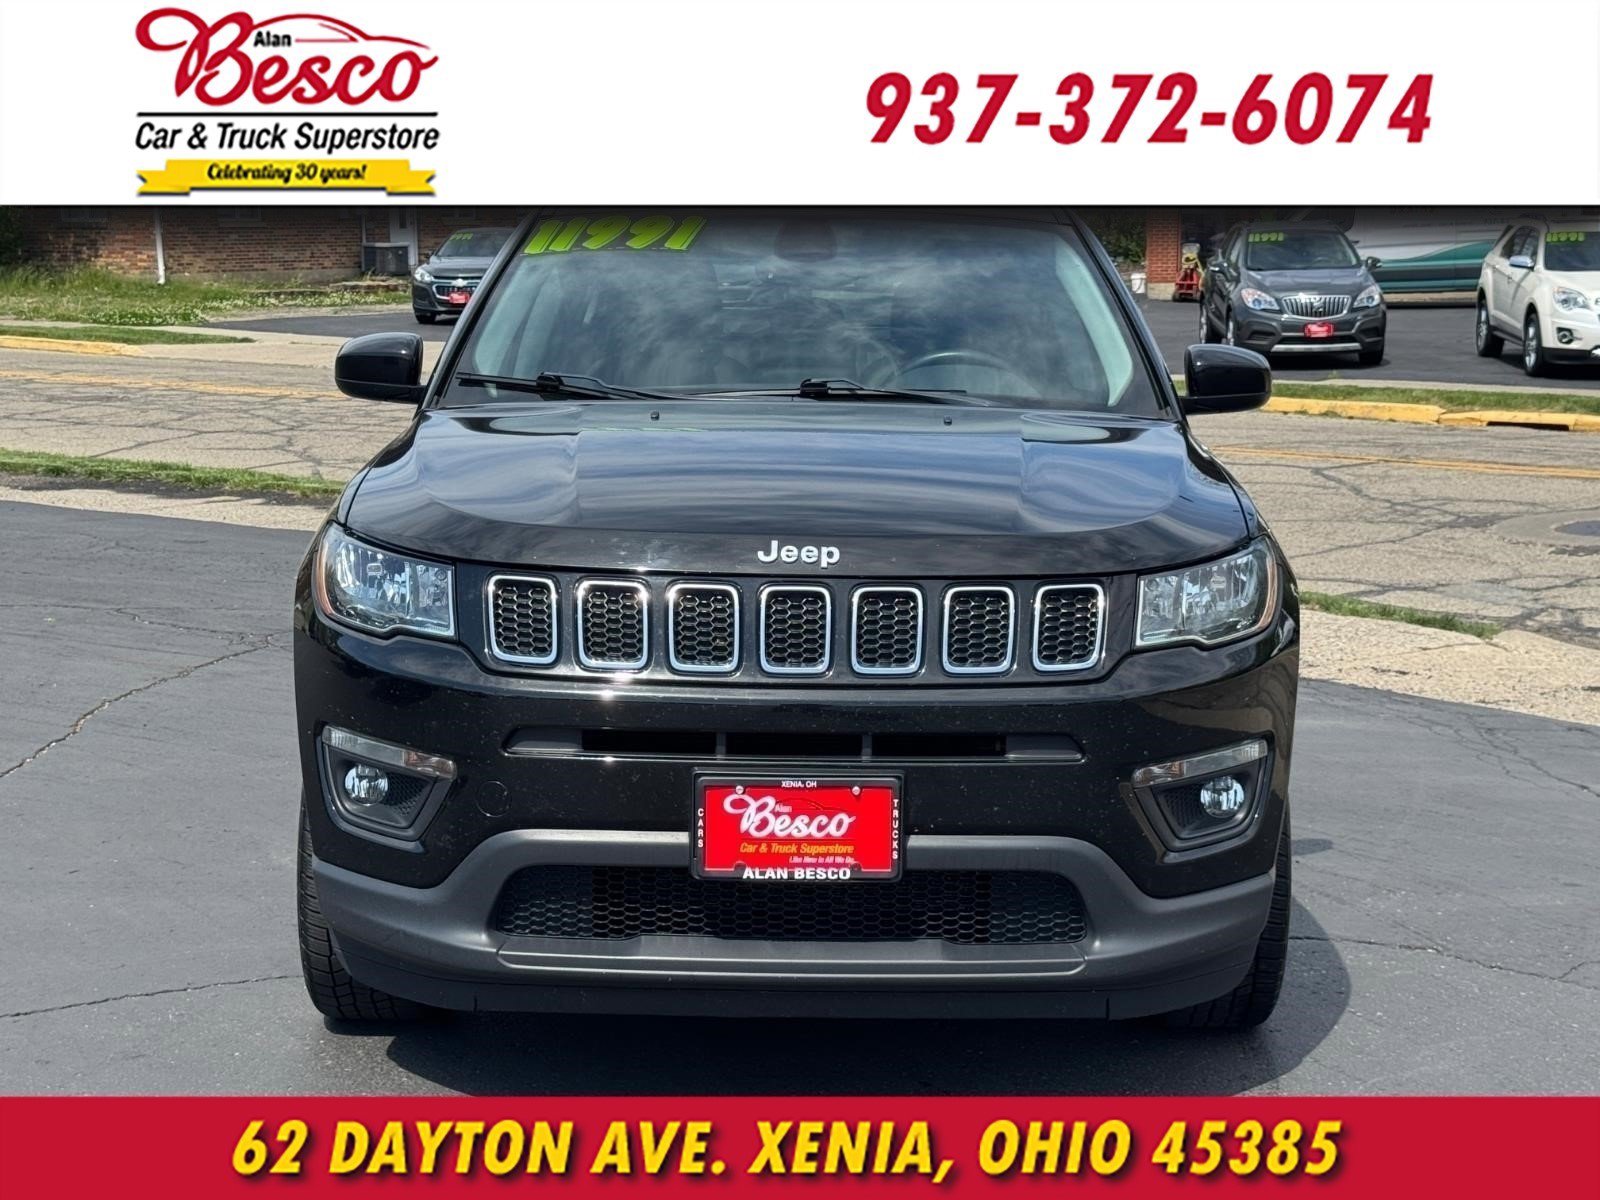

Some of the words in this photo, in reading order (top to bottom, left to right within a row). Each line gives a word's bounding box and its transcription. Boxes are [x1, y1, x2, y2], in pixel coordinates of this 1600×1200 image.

[523, 214, 706, 254] 11991
[757, 539, 840, 569] Jeep
[805, 780, 817, 788] OH
[723, 793, 856, 838] Besco
[740, 842, 758, 854] Car
[759, 843, 768, 853] &
[771, 842, 797, 854] Truck
[800, 842, 854, 855] Superstore
[742, 867, 788, 880] ALAN
[794, 867, 851, 880] BESCO
